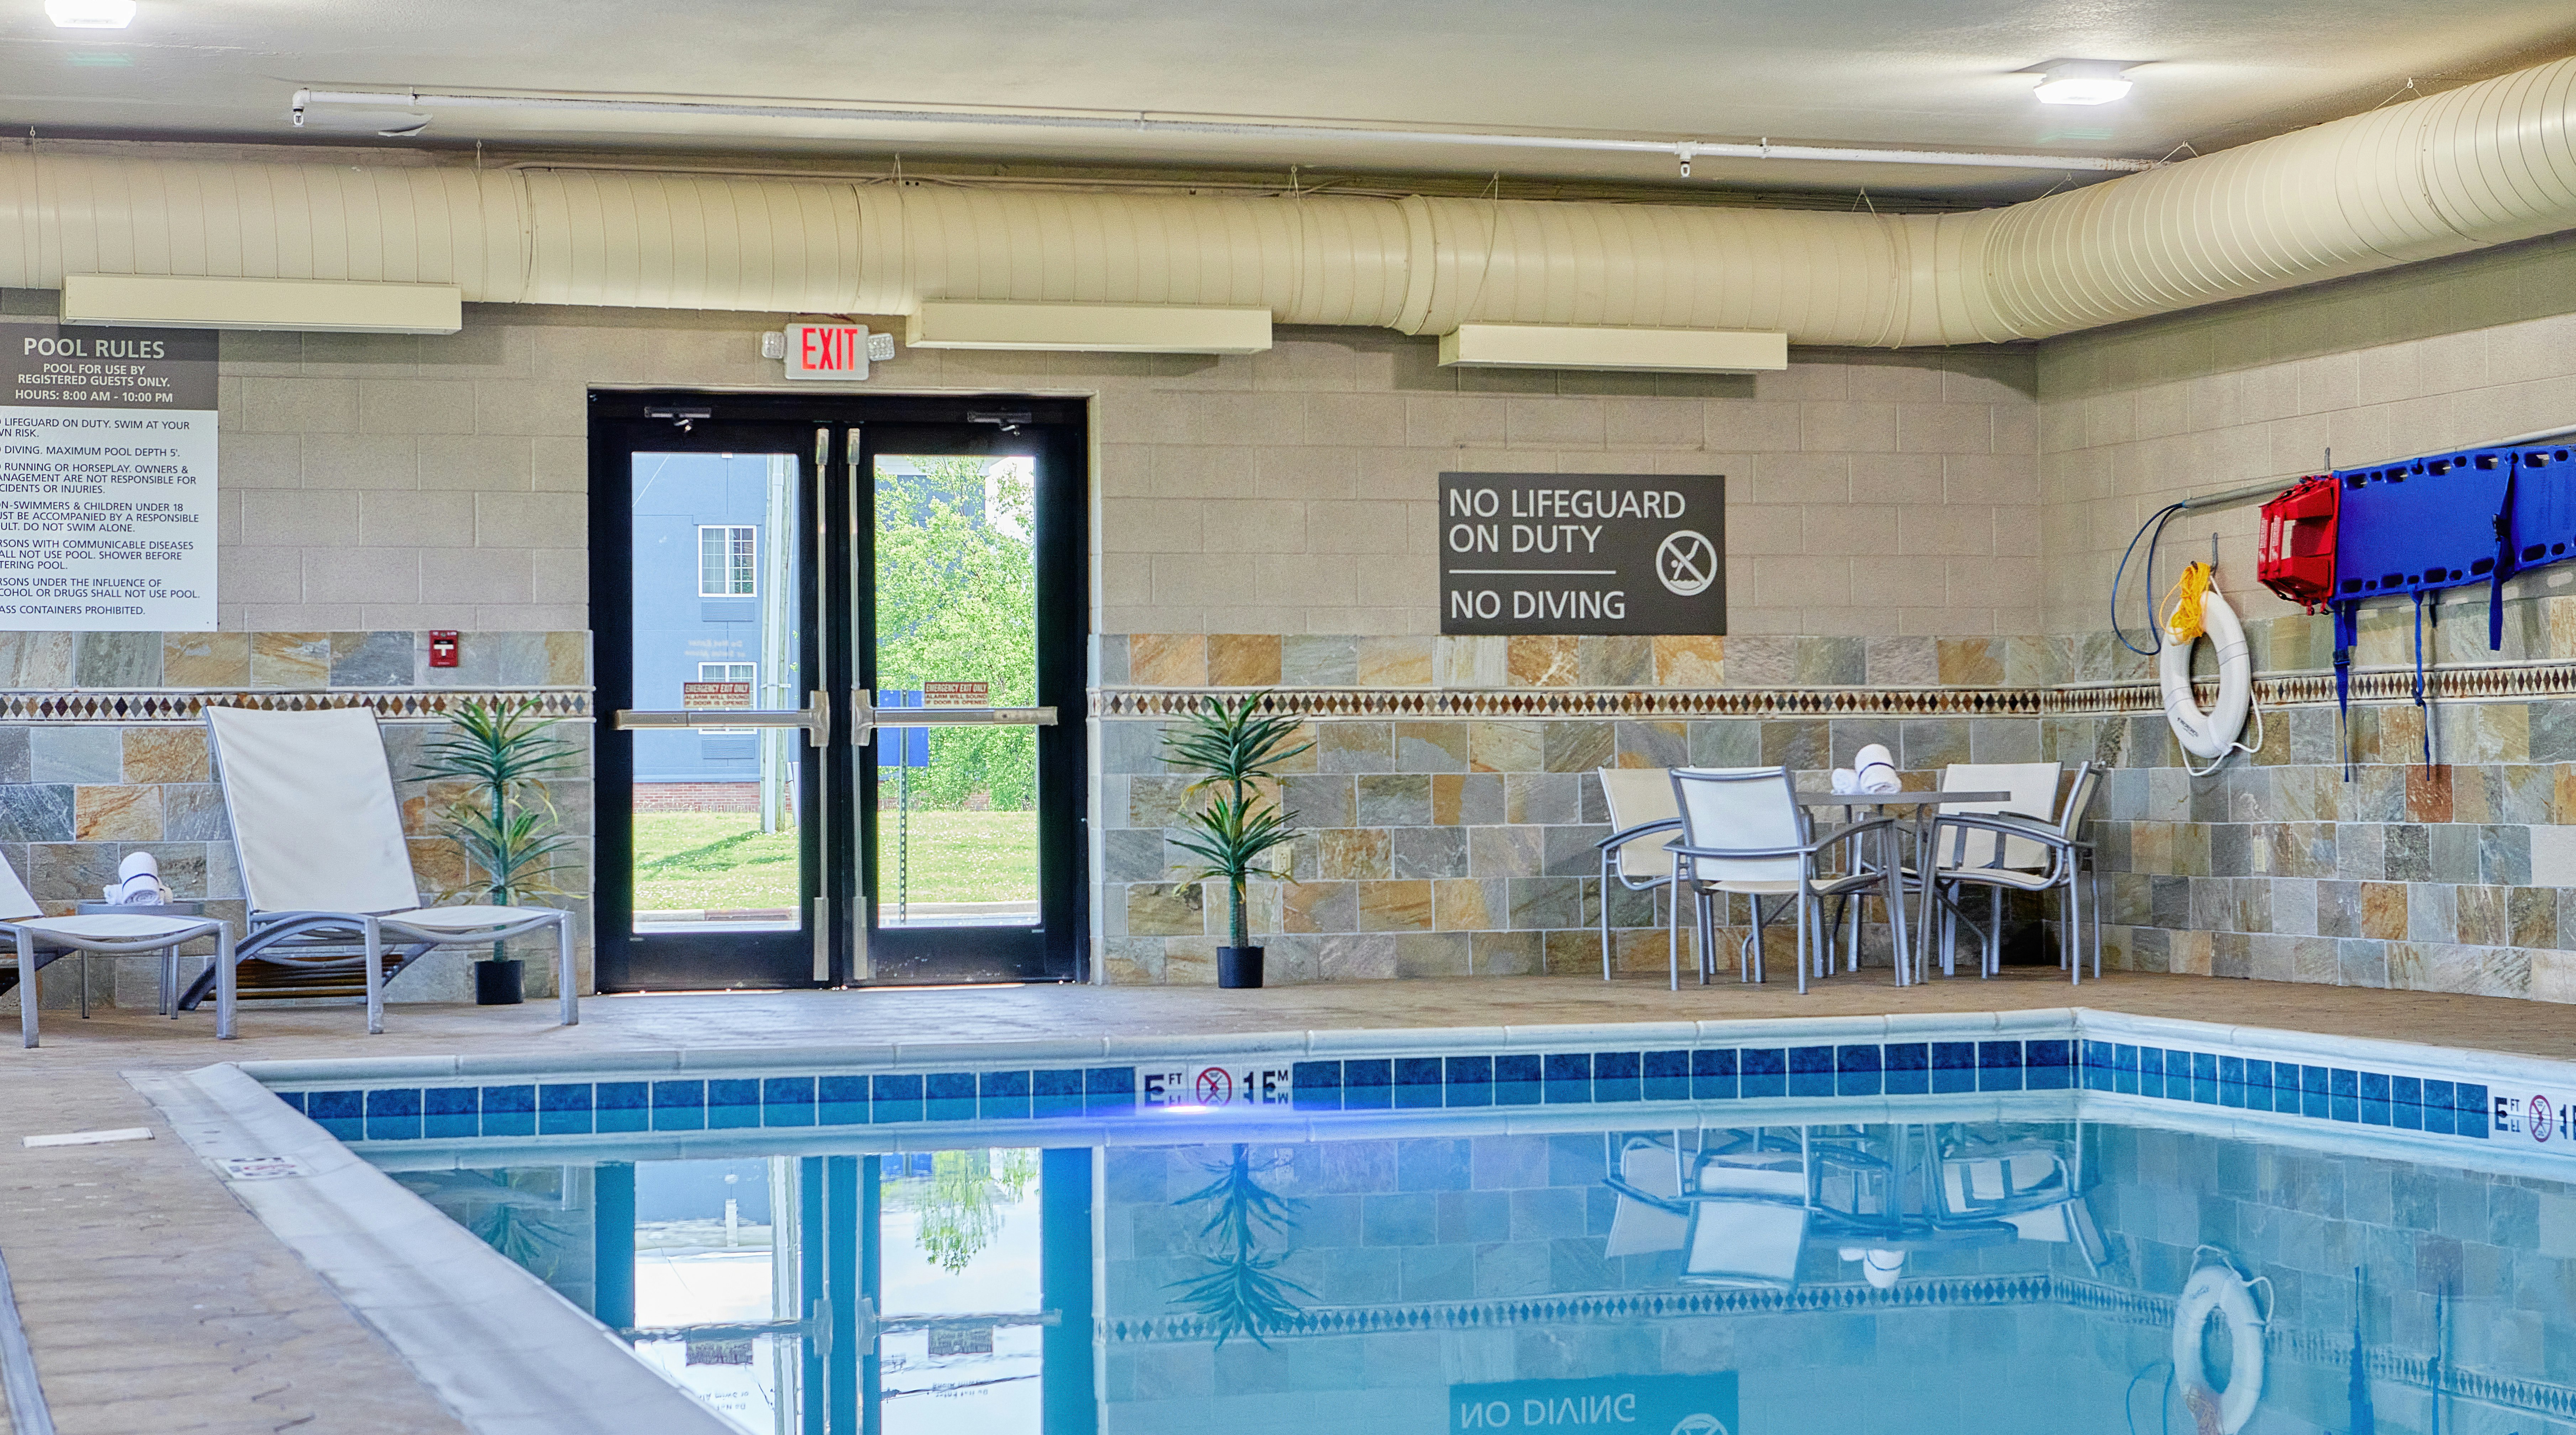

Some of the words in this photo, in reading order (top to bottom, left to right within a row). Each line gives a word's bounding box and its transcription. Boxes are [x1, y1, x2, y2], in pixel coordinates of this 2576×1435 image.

[25, 337, 87, 356] POOL
[96, 340, 164, 358] RULES
[802, 328, 858, 371] EXIT
[44, 363, 75, 373] POOL
[79, 364, 101, 374] FOR
[105, 365, 126, 375] USE
[131, 366, 146, 375] BY
[18, 374, 86, 385] REGISTERED
[90, 376, 134, 386] GUESTS
[138, 377, 170, 387] ONLY.
[15, 389, 59, 400] HOURS:
[63, 391, 87, 400] 8:00
[90, 391, 110, 401] AM
[122, 392, 152, 402] 10:00
[155, 393, 173, 402] PM
[5, 418, 59, 427] LIFEGUARD
[63, 419, 78, 428] ON
[82, 419, 111, 428] DUTY.
[114, 420, 142, 429] SWIM
[146, 421, 158, 429] AT
[162, 421, 190, 430] YOUR
[15, 429, 39, 437] RISK.
[5, 445, 42, 454] DIVING.
[46, 446, 101, 455] MAXIMUM
[105, 447, 132, 456] POOL
[135, 448, 167, 456] DEPTH
[5, 462, 51, 471] RUNNING
[54, 464, 69, 472] OR
[73, 464, 131, 473] HORSEPLAY.
[135, 465, 178, 474] OWNERS
[181, 466, 188, 474] &
[63, 474, 82, 482] ARE
[87, 475, 108, 483] NOT
[111, 475, 173, 484] RESPONSIBLE
[177, 476, 196, 485] FOR
[43, 485, 57, 493] OR
[61, 485, 105, 493] INJURIES.
[0, 501, 69, 510] N-SWIMMERS
[84, 502, 132, 511] CHILDREN
[136, 503, 169, 511] UNDER
[174, 503, 183, 512] 18
[1450, 488, 1499, 517] NO
[1512, 489, 1686, 518] LIFEGUARD
[17, 512, 28, 520] BE
[32, 512, 106, 521] ACCOMPANIED
[110, 513, 122, 521] BY
[137, 513, 199, 523] RESPONSIBLE
[23, 523, 39, 531] DO
[67, 523, 95, 531] SWIM
[99, 524, 135, 532] ALONE.
[1449, 524, 1498, 553] ON
[1512, 525, 1603, 553] DUTY
[63, 540, 145, 549] COMMUNICABLE
[149, 541, 194, 550] DISEASES
[19, 550, 41, 558] NOT
[44, 550, 62, 559] USE
[66, 551, 96, 559] POOL.
[99, 551, 142, 560] SHOWER
[146, 551, 182, 560] BEFORE
[38, 561, 68, 569] POOL.
[33, 578, 67, 586] UNDER
[70, 578, 89, 587] THE
[93, 578, 145, 587] INFLUENCE
[148, 579, 161, 587] OF
[36, 588, 51, 597] OR
[54, 589, 88, 597] DRUGS
[91, 589, 121, 597] SHALL
[125, 590, 146, 598] NOT
[149, 590, 167, 598] USE
[170, 590, 200, 598] POOL.
[20, 605, 82, 614] CONTAINERS
[85, 606, 145, 614] PROHIBITED.
[1451, 590, 1501, 619] NO
[1513, 591, 1625, 619] DIVING
[926, 684, 959, 692] EMERGENCY
[960, 684, 972, 692] EXIT
[972, 684, 987, 692] ONLY
[1169, 1072, 1182, 1085] FT
[1277, 1069, 1288, 1081] M
[2510, 1098, 2520, 1111] FT
